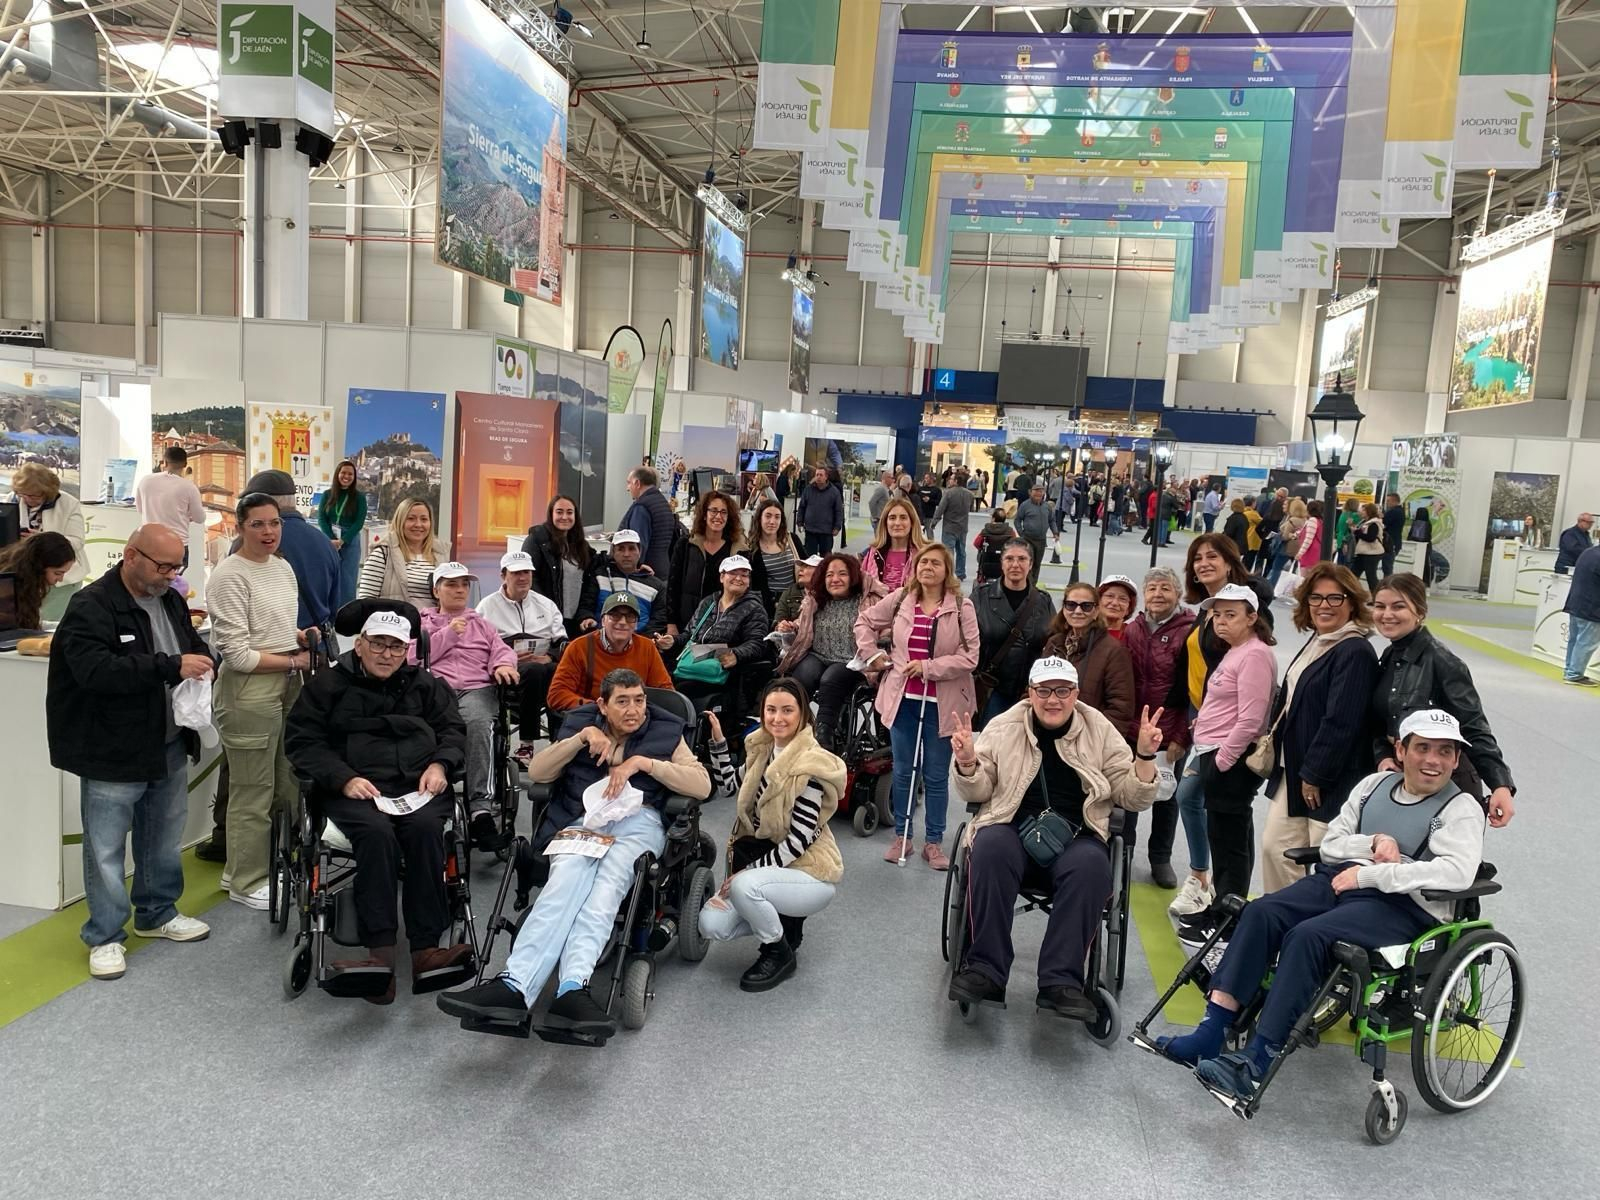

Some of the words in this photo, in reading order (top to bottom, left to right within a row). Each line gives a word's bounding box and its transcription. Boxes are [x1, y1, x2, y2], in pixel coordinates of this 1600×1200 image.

[242, 36, 287, 45] DIPUTACIÓN
[242, 45, 252, 53] DE
[253, 44, 272, 53] JAÉN
[468, 122, 501, 161] Sierra
[501, 146, 515, 169] de
[939, 371, 951, 388] 4
[1012, 420, 1047, 429] PUEBLOS
[956, 435, 992, 444] PUEBLOS
[296, 496, 301, 506] E
[107, 551, 116, 559] La
